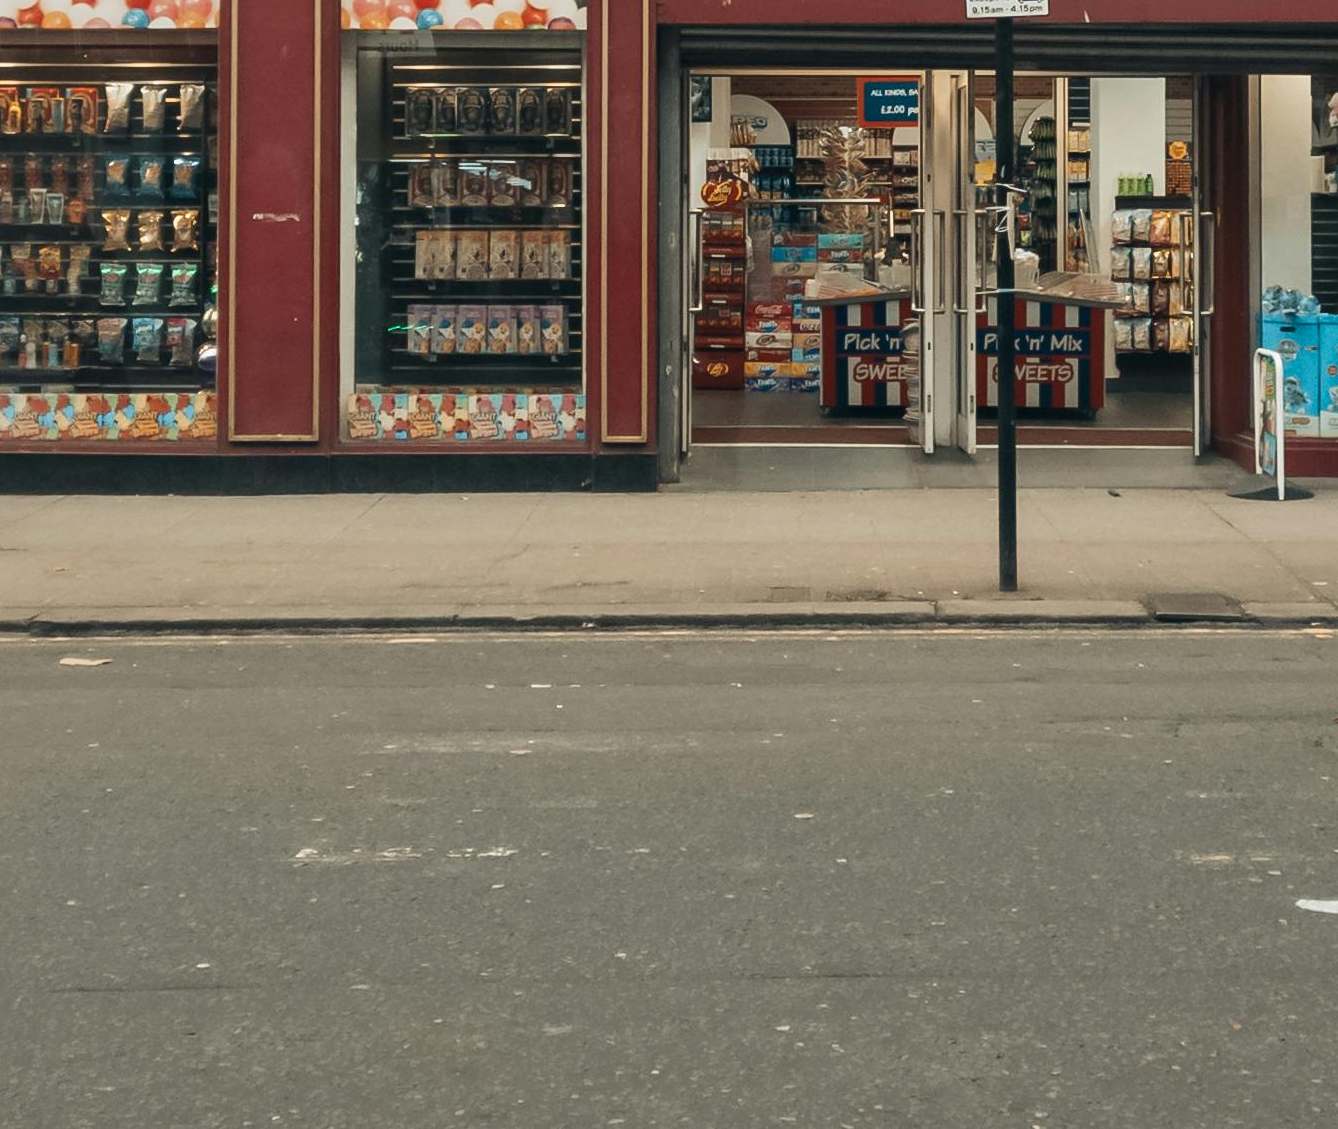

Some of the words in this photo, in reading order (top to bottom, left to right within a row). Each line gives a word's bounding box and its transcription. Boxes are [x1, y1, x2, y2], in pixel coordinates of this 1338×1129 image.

[844, 333, 881, 350] Pick
[885, 334, 901, 350] 'n
[984, 333, 1021, 351] Pk
[1050, 334, 1083, 351] Mix
[855, 364, 910, 381] SWEE
[995, 364, 1073, 382] WEETS
